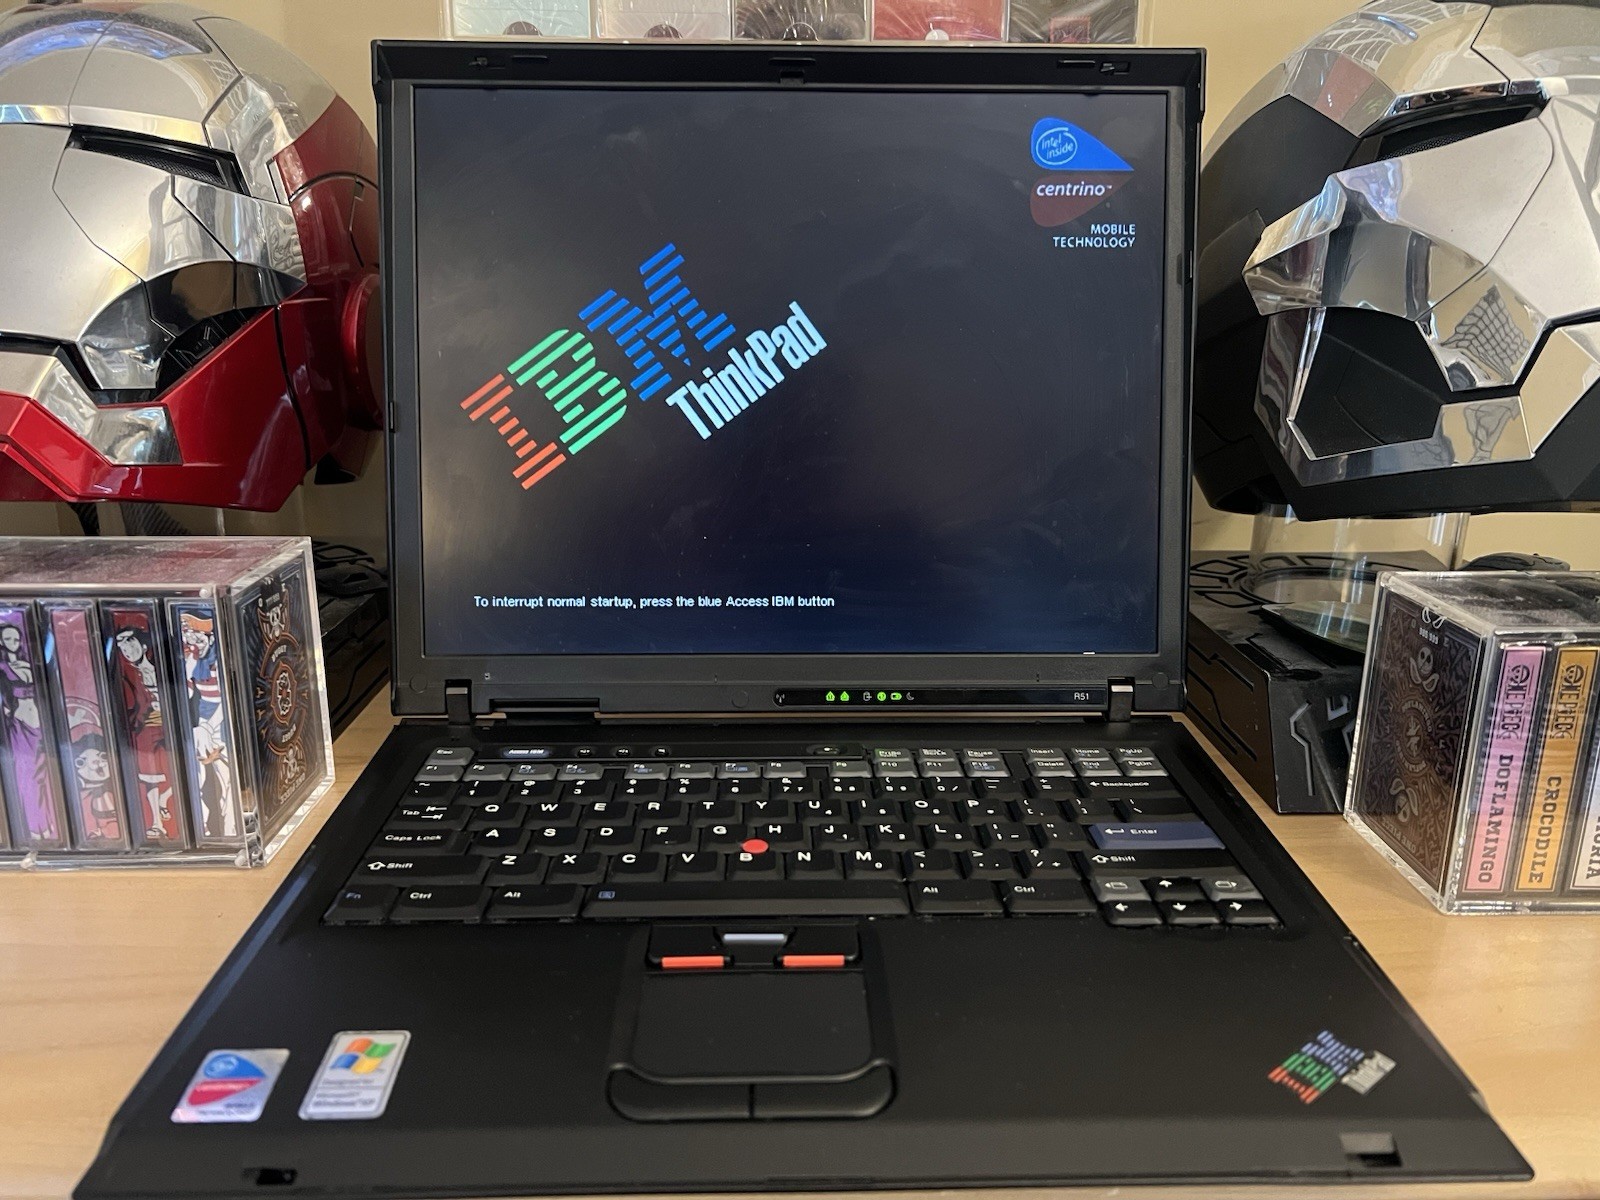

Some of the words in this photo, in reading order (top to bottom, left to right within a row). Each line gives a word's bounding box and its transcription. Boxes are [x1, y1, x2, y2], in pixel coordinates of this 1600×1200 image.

[1090, 223, 1136, 235] MOBILE
[1053, 236, 1136, 248] TECHNOLOGY
[460, 242, 736, 490] IBM
[665, 300, 828, 440] ThinkPad
[474, 595, 489, 607] To
[492, 595, 544, 609] interrupt
[547, 595, 586, 607] normal
[590, 596, 637, 609] startup,
[639, 598, 673, 609] press
[676, 596, 695, 607] the
[697, 596, 722, 607] blue
[725, 596, 769, 607] Access
[771, 596, 795, 607] IBM
[797, 596, 835, 607] button
[1074, 692, 1089, 700] R51
[484, 804, 500, 813] Q
[540, 803, 558, 811] W
[593, 802, 607, 811] E
[647, 802, 661, 810] R
[703, 801, 714, 809] T
[756, 801, 768, 809] Y
[808, 800, 820, 809] U
[914, 800, 929, 808] O
[1477, 754, 1514, 883] DOFLAMINGO
[485, 828, 500, 838] A
[543, 828, 556, 837] S
[599, 827, 614, 836] D
[656, 826, 669, 835] F
[712, 826, 727, 835] G
[768, 825, 782, 834] H
[824, 825, 834, 833] J
[880, 824, 893, 833] K
[934, 824, 947, 833] L
[1528, 776, 1562, 883] CROCODILE
[385, 834, 413, 842] Caps
[1586, 815, 1600, 880] ORIA
[501, 855, 517, 865] Z
[562, 854, 577, 864] X
[622, 854, 637, 863] C
[681, 853, 695, 863] V
[739, 852, 753, 862] B
[797, 851, 811, 861] N
[855, 850, 872, 861] M
[503, 890, 521, 898] Alt
[922, 886, 939, 894] Alt
[1013, 885, 1036, 894] Ctrl
[409, 891, 433, 899] Ctrl
